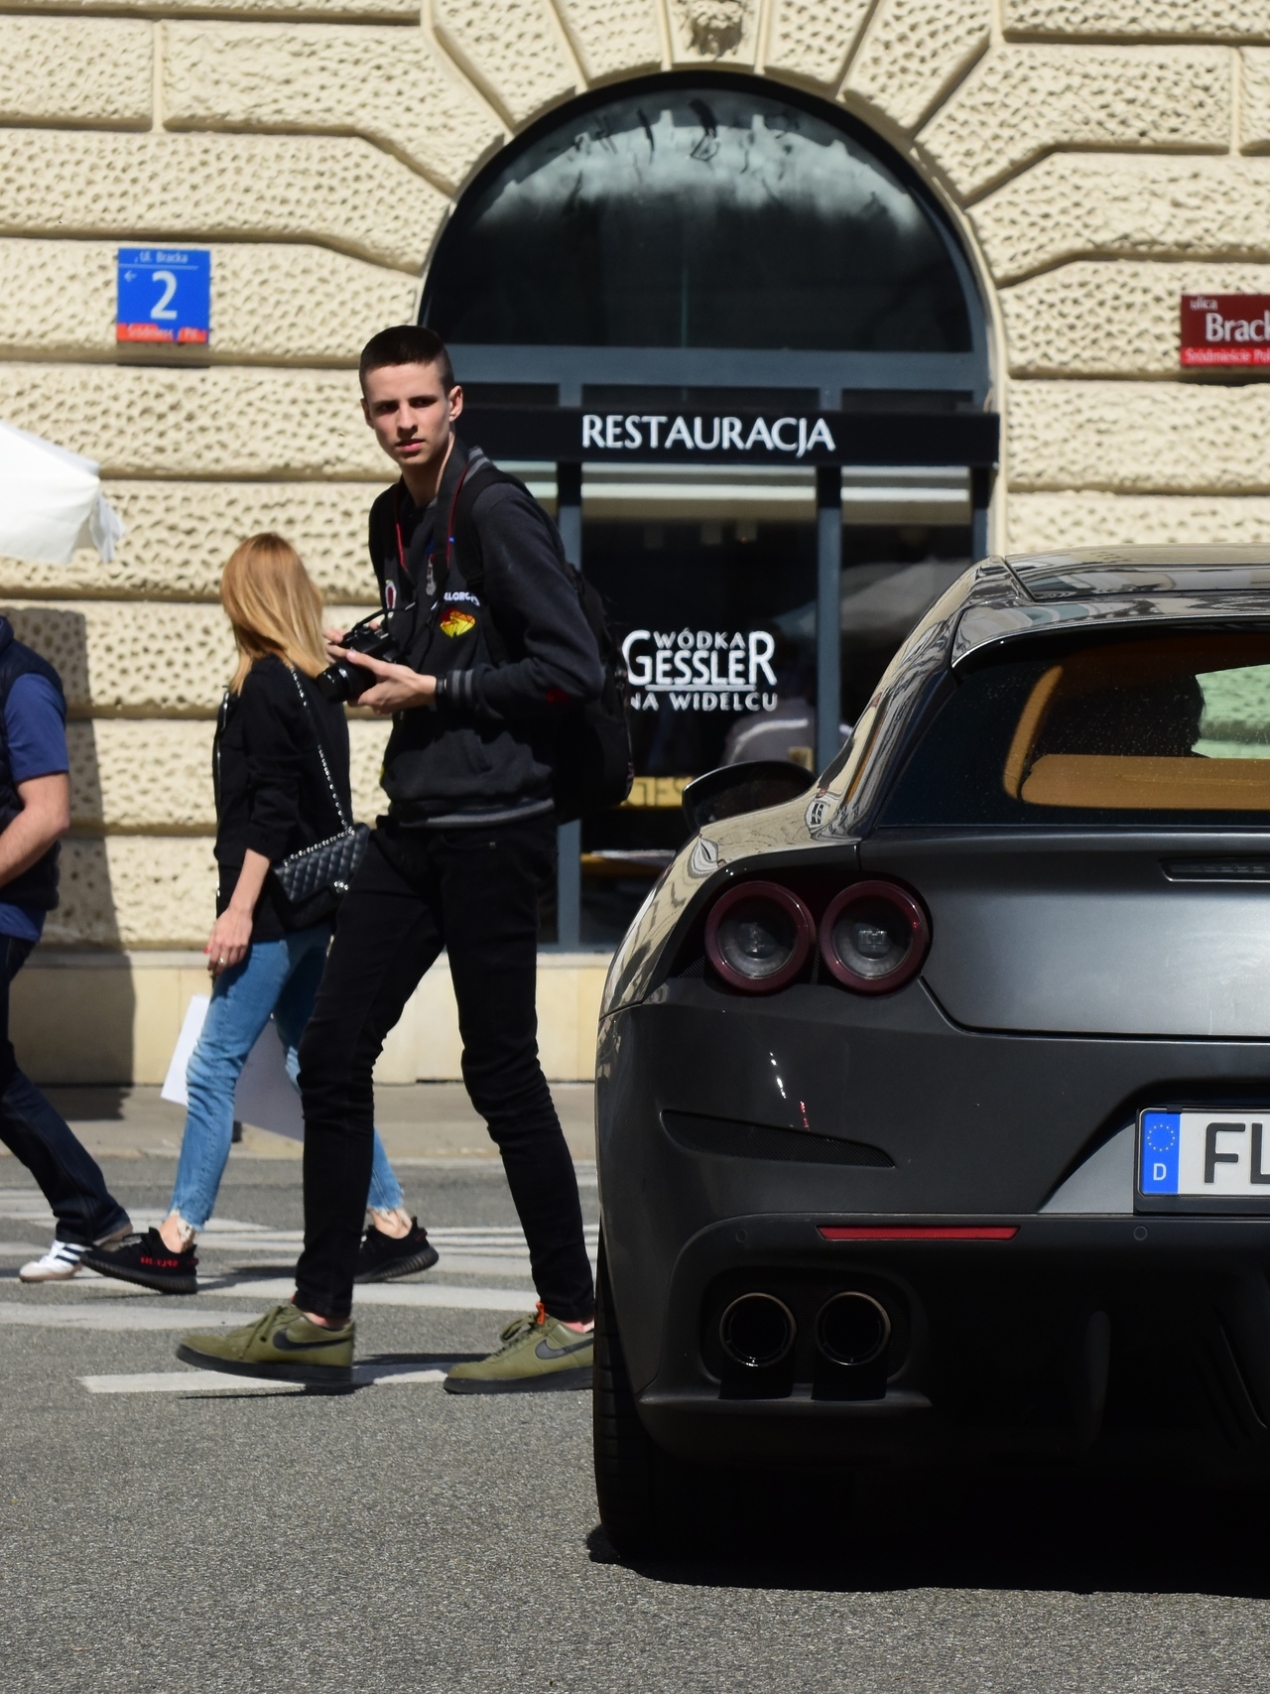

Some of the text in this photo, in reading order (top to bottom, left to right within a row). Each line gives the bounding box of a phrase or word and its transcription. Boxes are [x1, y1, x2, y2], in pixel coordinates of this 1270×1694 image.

[150, 270, 178, 320] 2
[1190, 297, 1218, 311] ulica
[582, 414, 836, 459] RESTAURACJA
[653, 627, 746, 650] WÓDKA
[622, 629, 777, 686] GESSLER
[669, 692, 778, 711] WIDELCU
[1152, 1162, 1168, 1182] D
